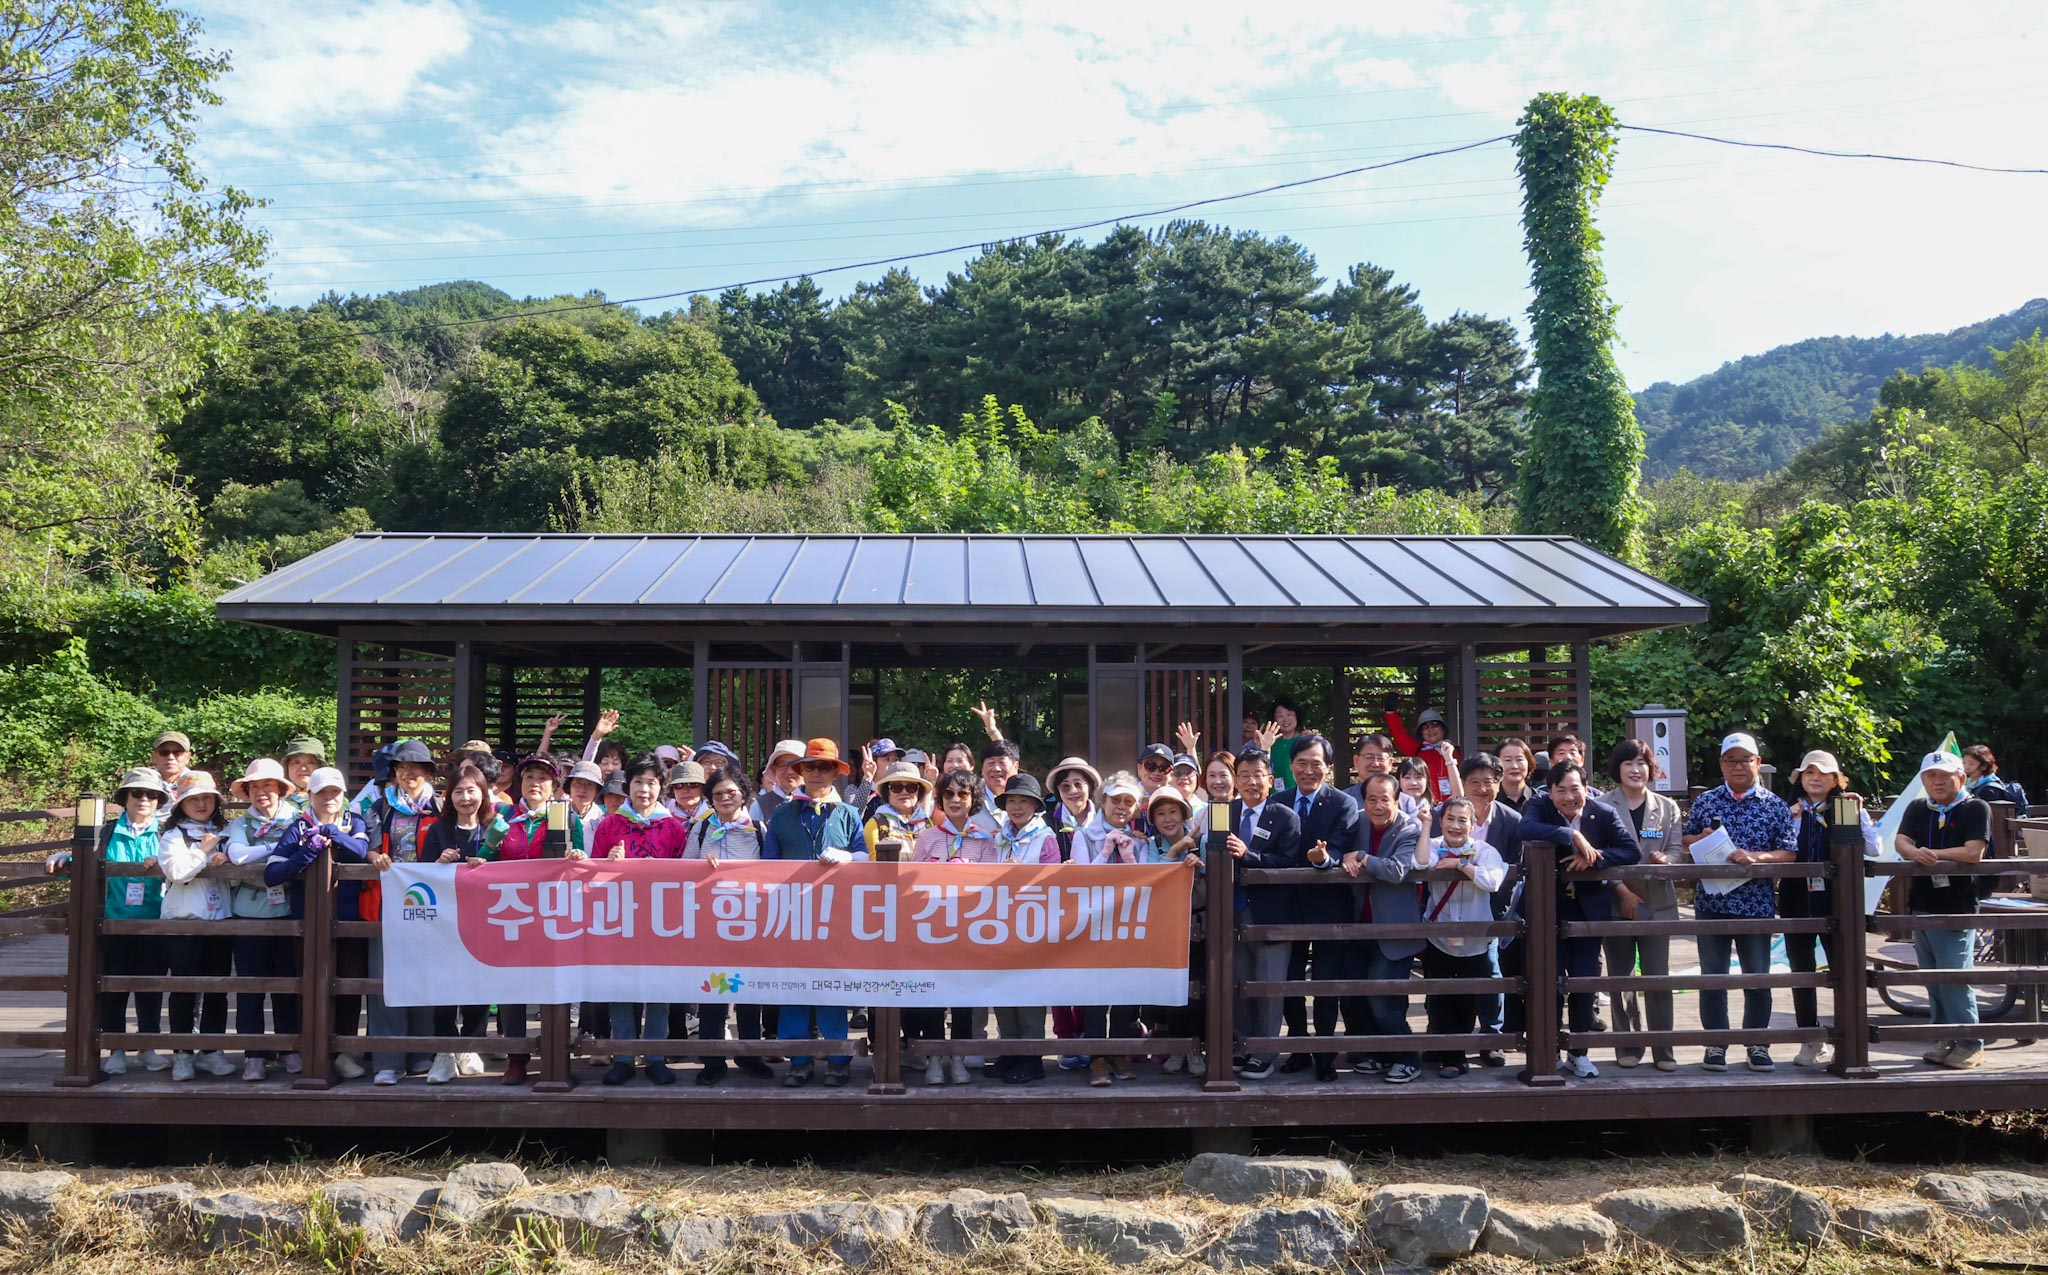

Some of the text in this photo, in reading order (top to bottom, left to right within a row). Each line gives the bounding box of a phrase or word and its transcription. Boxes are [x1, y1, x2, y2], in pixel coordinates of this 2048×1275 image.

[403, 908, 438, 921] 대덕구
[487, 880, 1152, 944] 주민과 다 함께! 더 건강하게!!
[748, 980, 807, 991] 다 함께 더 건강하게
[811, 980, 842, 991] 대덕구
